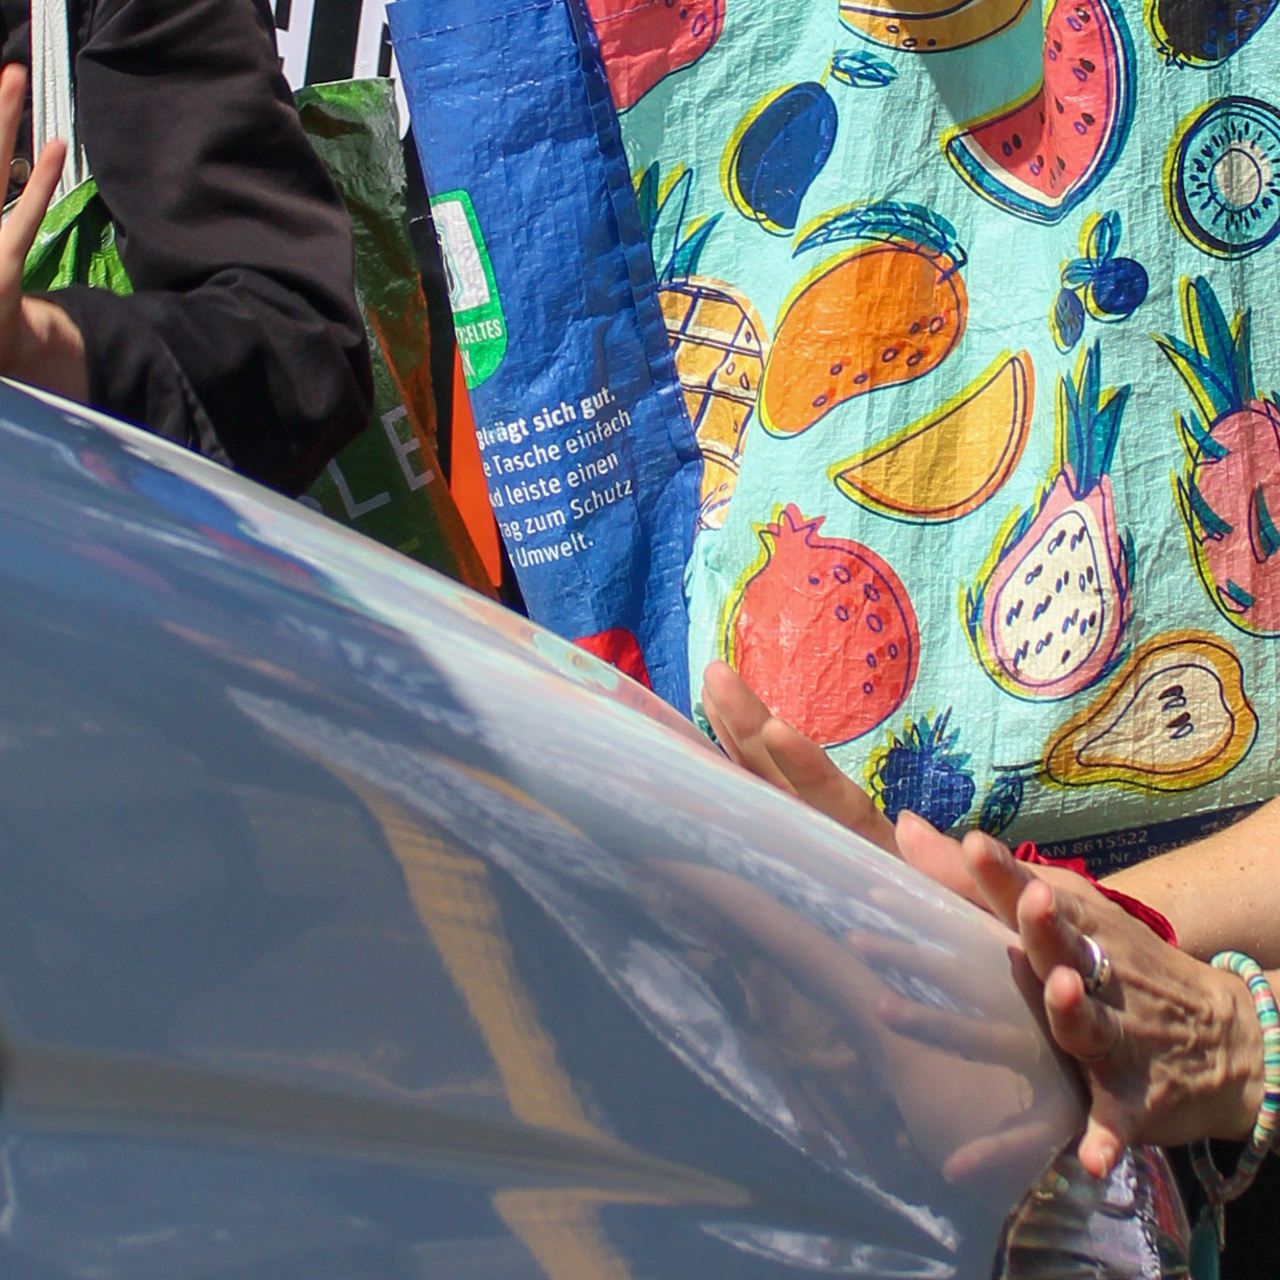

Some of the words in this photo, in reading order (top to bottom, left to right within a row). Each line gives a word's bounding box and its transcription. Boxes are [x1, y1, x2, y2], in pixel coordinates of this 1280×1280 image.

[532, 401, 577, 433] sich
[580, 386, 616, 420] gut.
[492, 444, 562, 475] Tasche
[566, 409, 632, 454] einfach
[505, 476, 562, 507] leiste
[566, 452, 620, 488] einen
[524, 509, 566, 535] zum
[570, 479, 634, 520] Schutz
[515, 531, 595, 568] Umwelt.
[1073, 830, 1149, 855] 8615522
